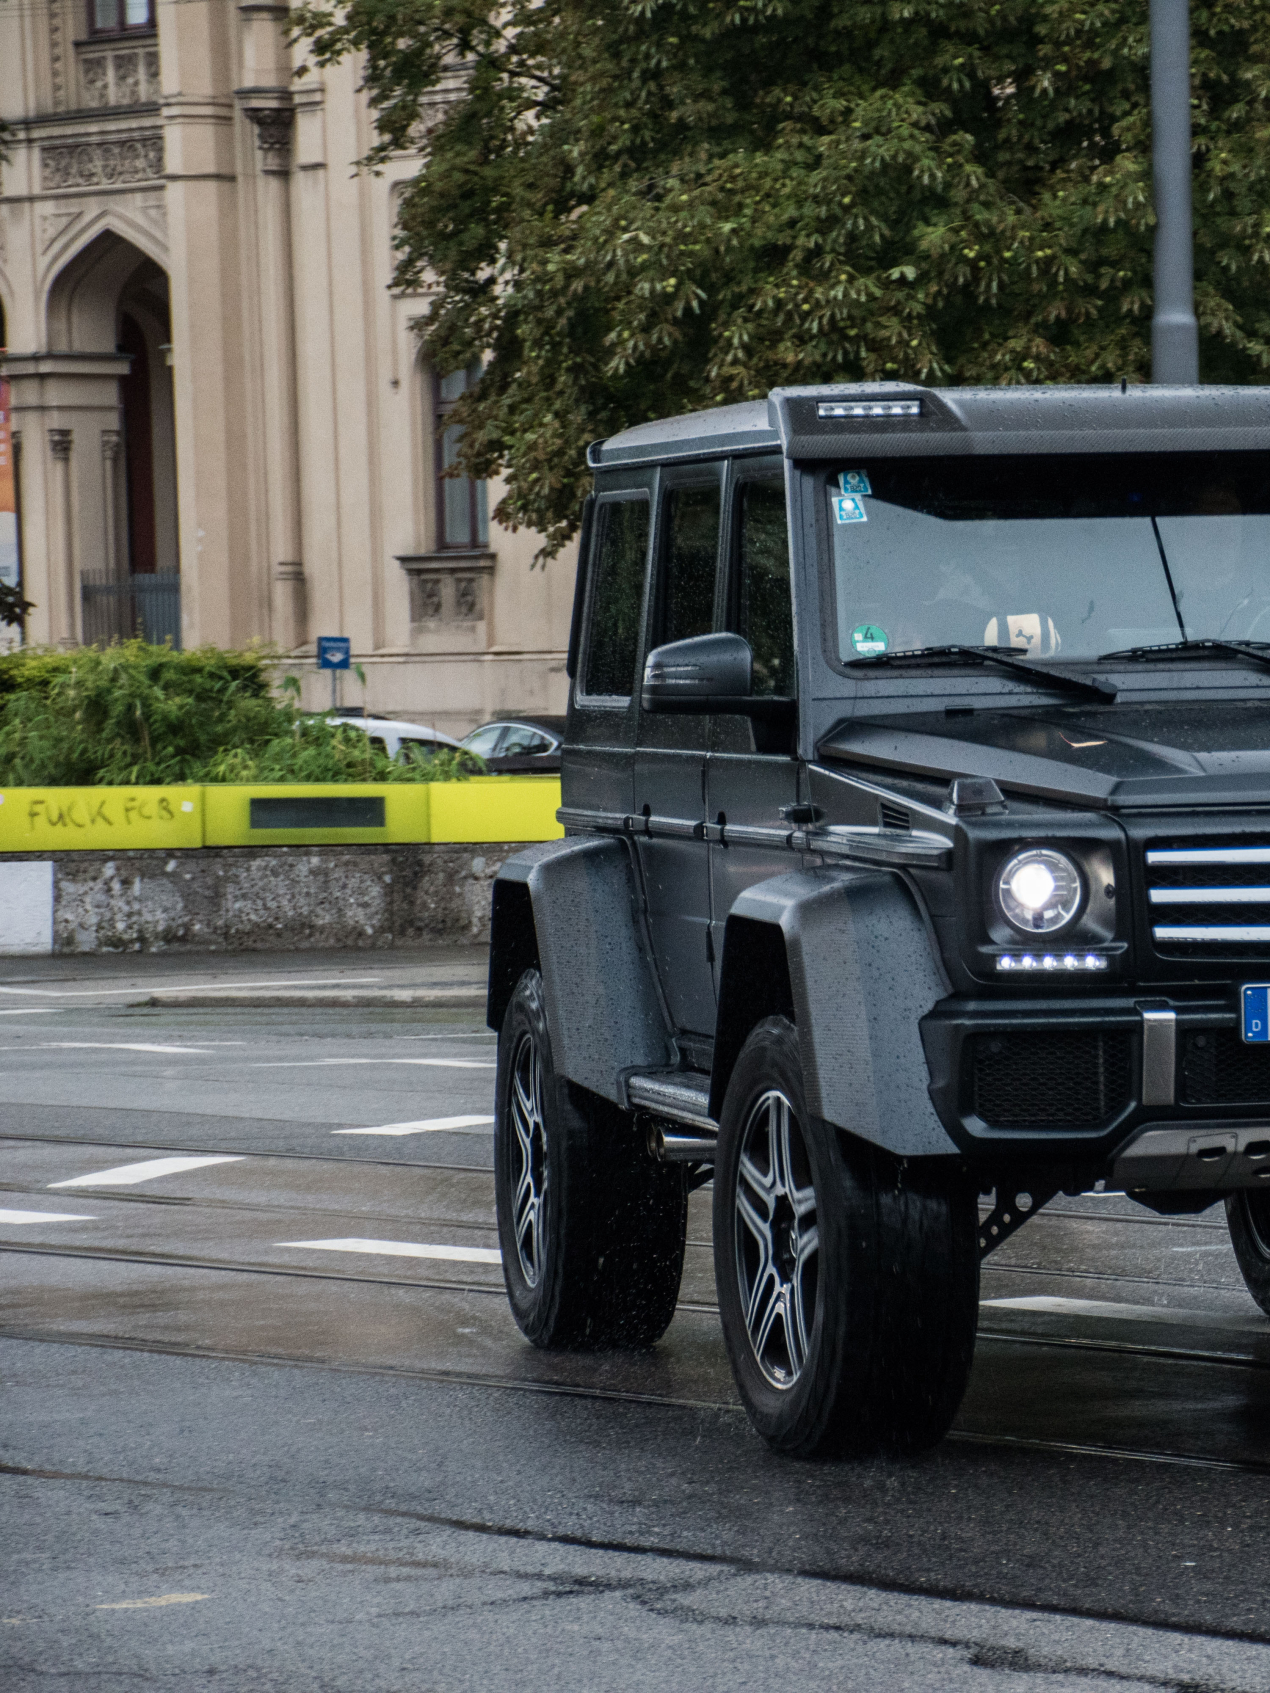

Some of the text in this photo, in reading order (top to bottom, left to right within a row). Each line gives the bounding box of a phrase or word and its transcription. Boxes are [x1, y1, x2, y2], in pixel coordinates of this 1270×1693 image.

[864, 626, 875, 641] 4
[28, 796, 175, 831] FUCK FCB
[1251, 1020, 1261, 1031] D
